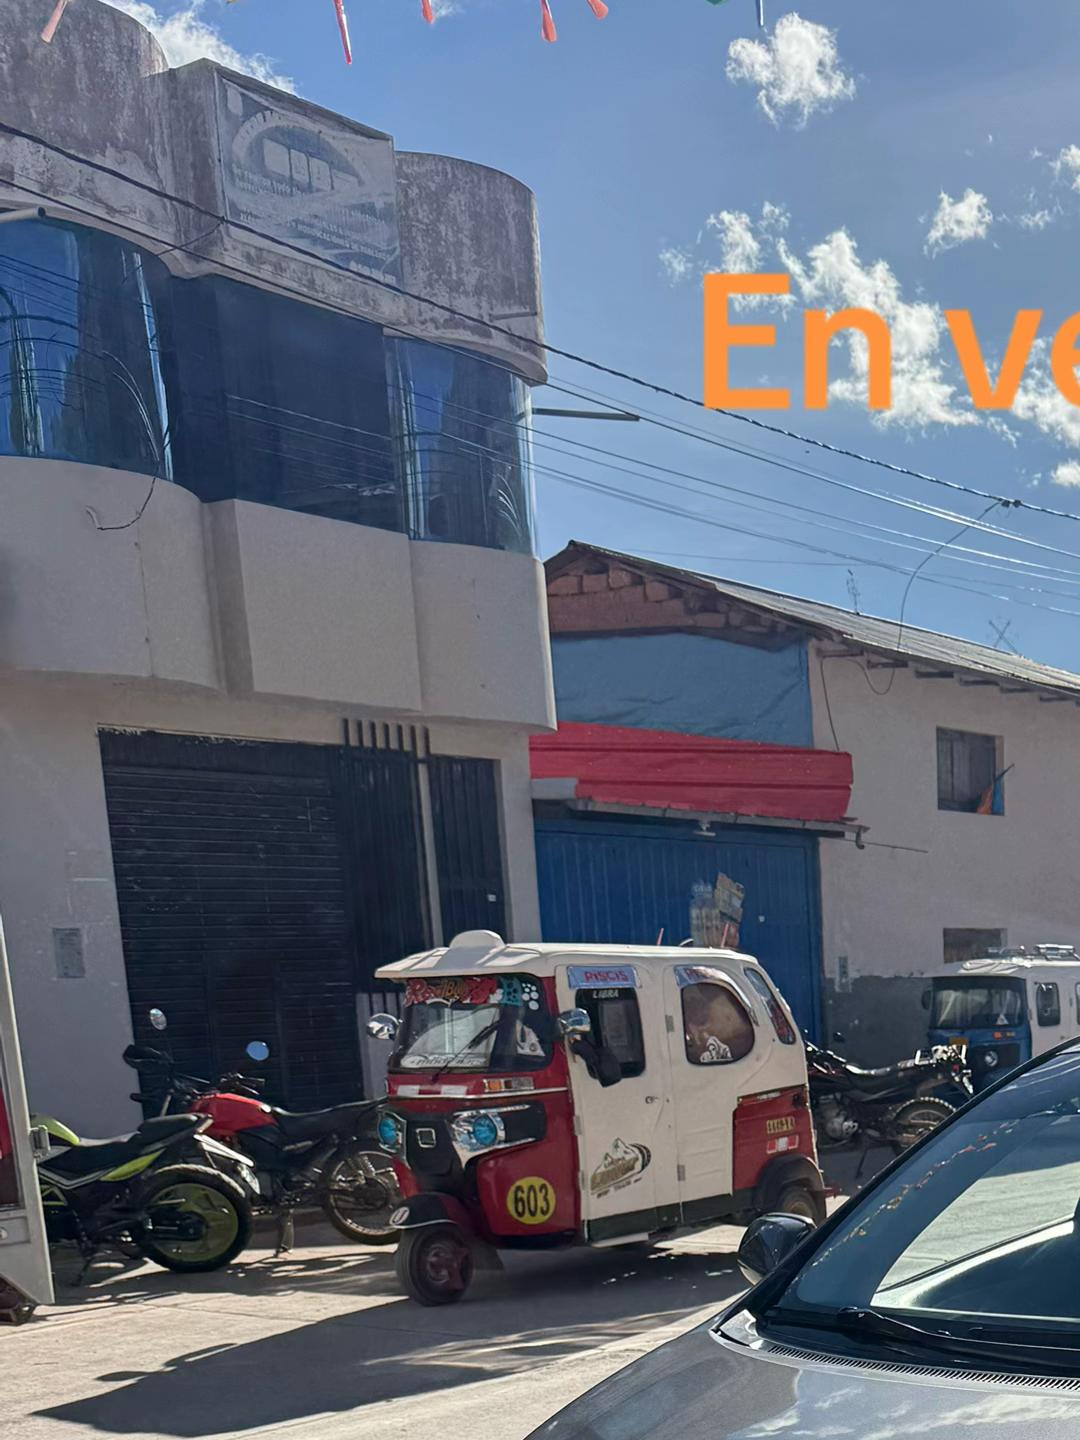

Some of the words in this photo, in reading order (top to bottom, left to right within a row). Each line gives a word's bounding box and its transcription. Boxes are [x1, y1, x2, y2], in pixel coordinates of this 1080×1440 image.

[583, 969, 630, 983] PISCIS
[592, 988, 620, 999] LIBRA
[513, 1183, 551, 1219] 603
